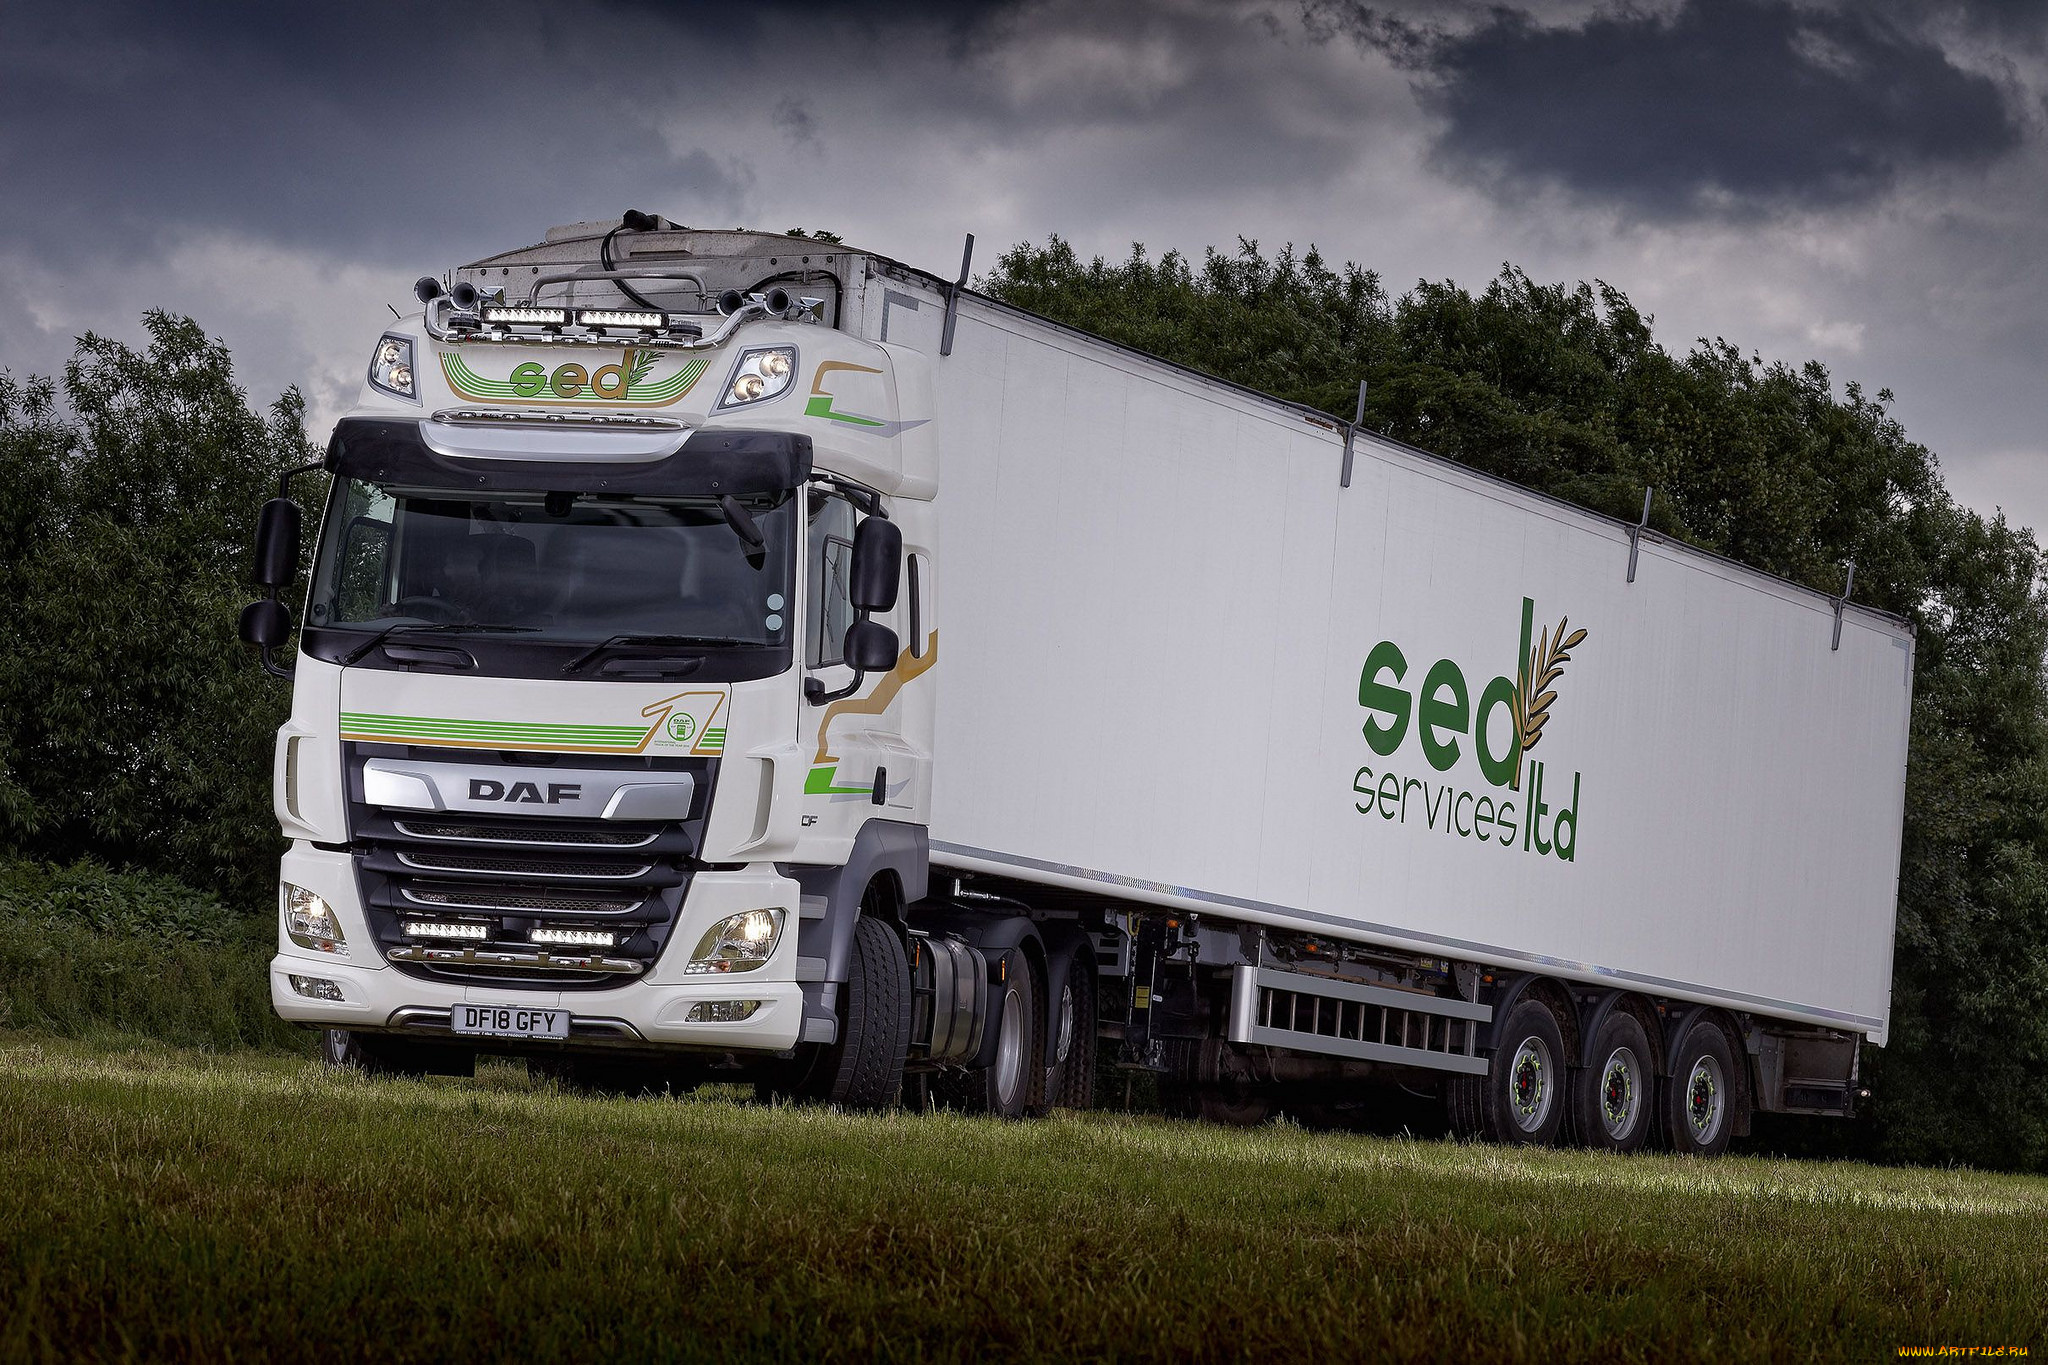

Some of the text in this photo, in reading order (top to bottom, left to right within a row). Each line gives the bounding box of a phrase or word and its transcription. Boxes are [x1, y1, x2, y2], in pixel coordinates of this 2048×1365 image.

[509, 349, 635, 400] sed
[1358, 596, 1535, 793] sed
[468, 778, 582, 805] DAF
[1353, 759, 1581, 863] services ltd
[465, 1008, 556, 1033] DF18 GFY
